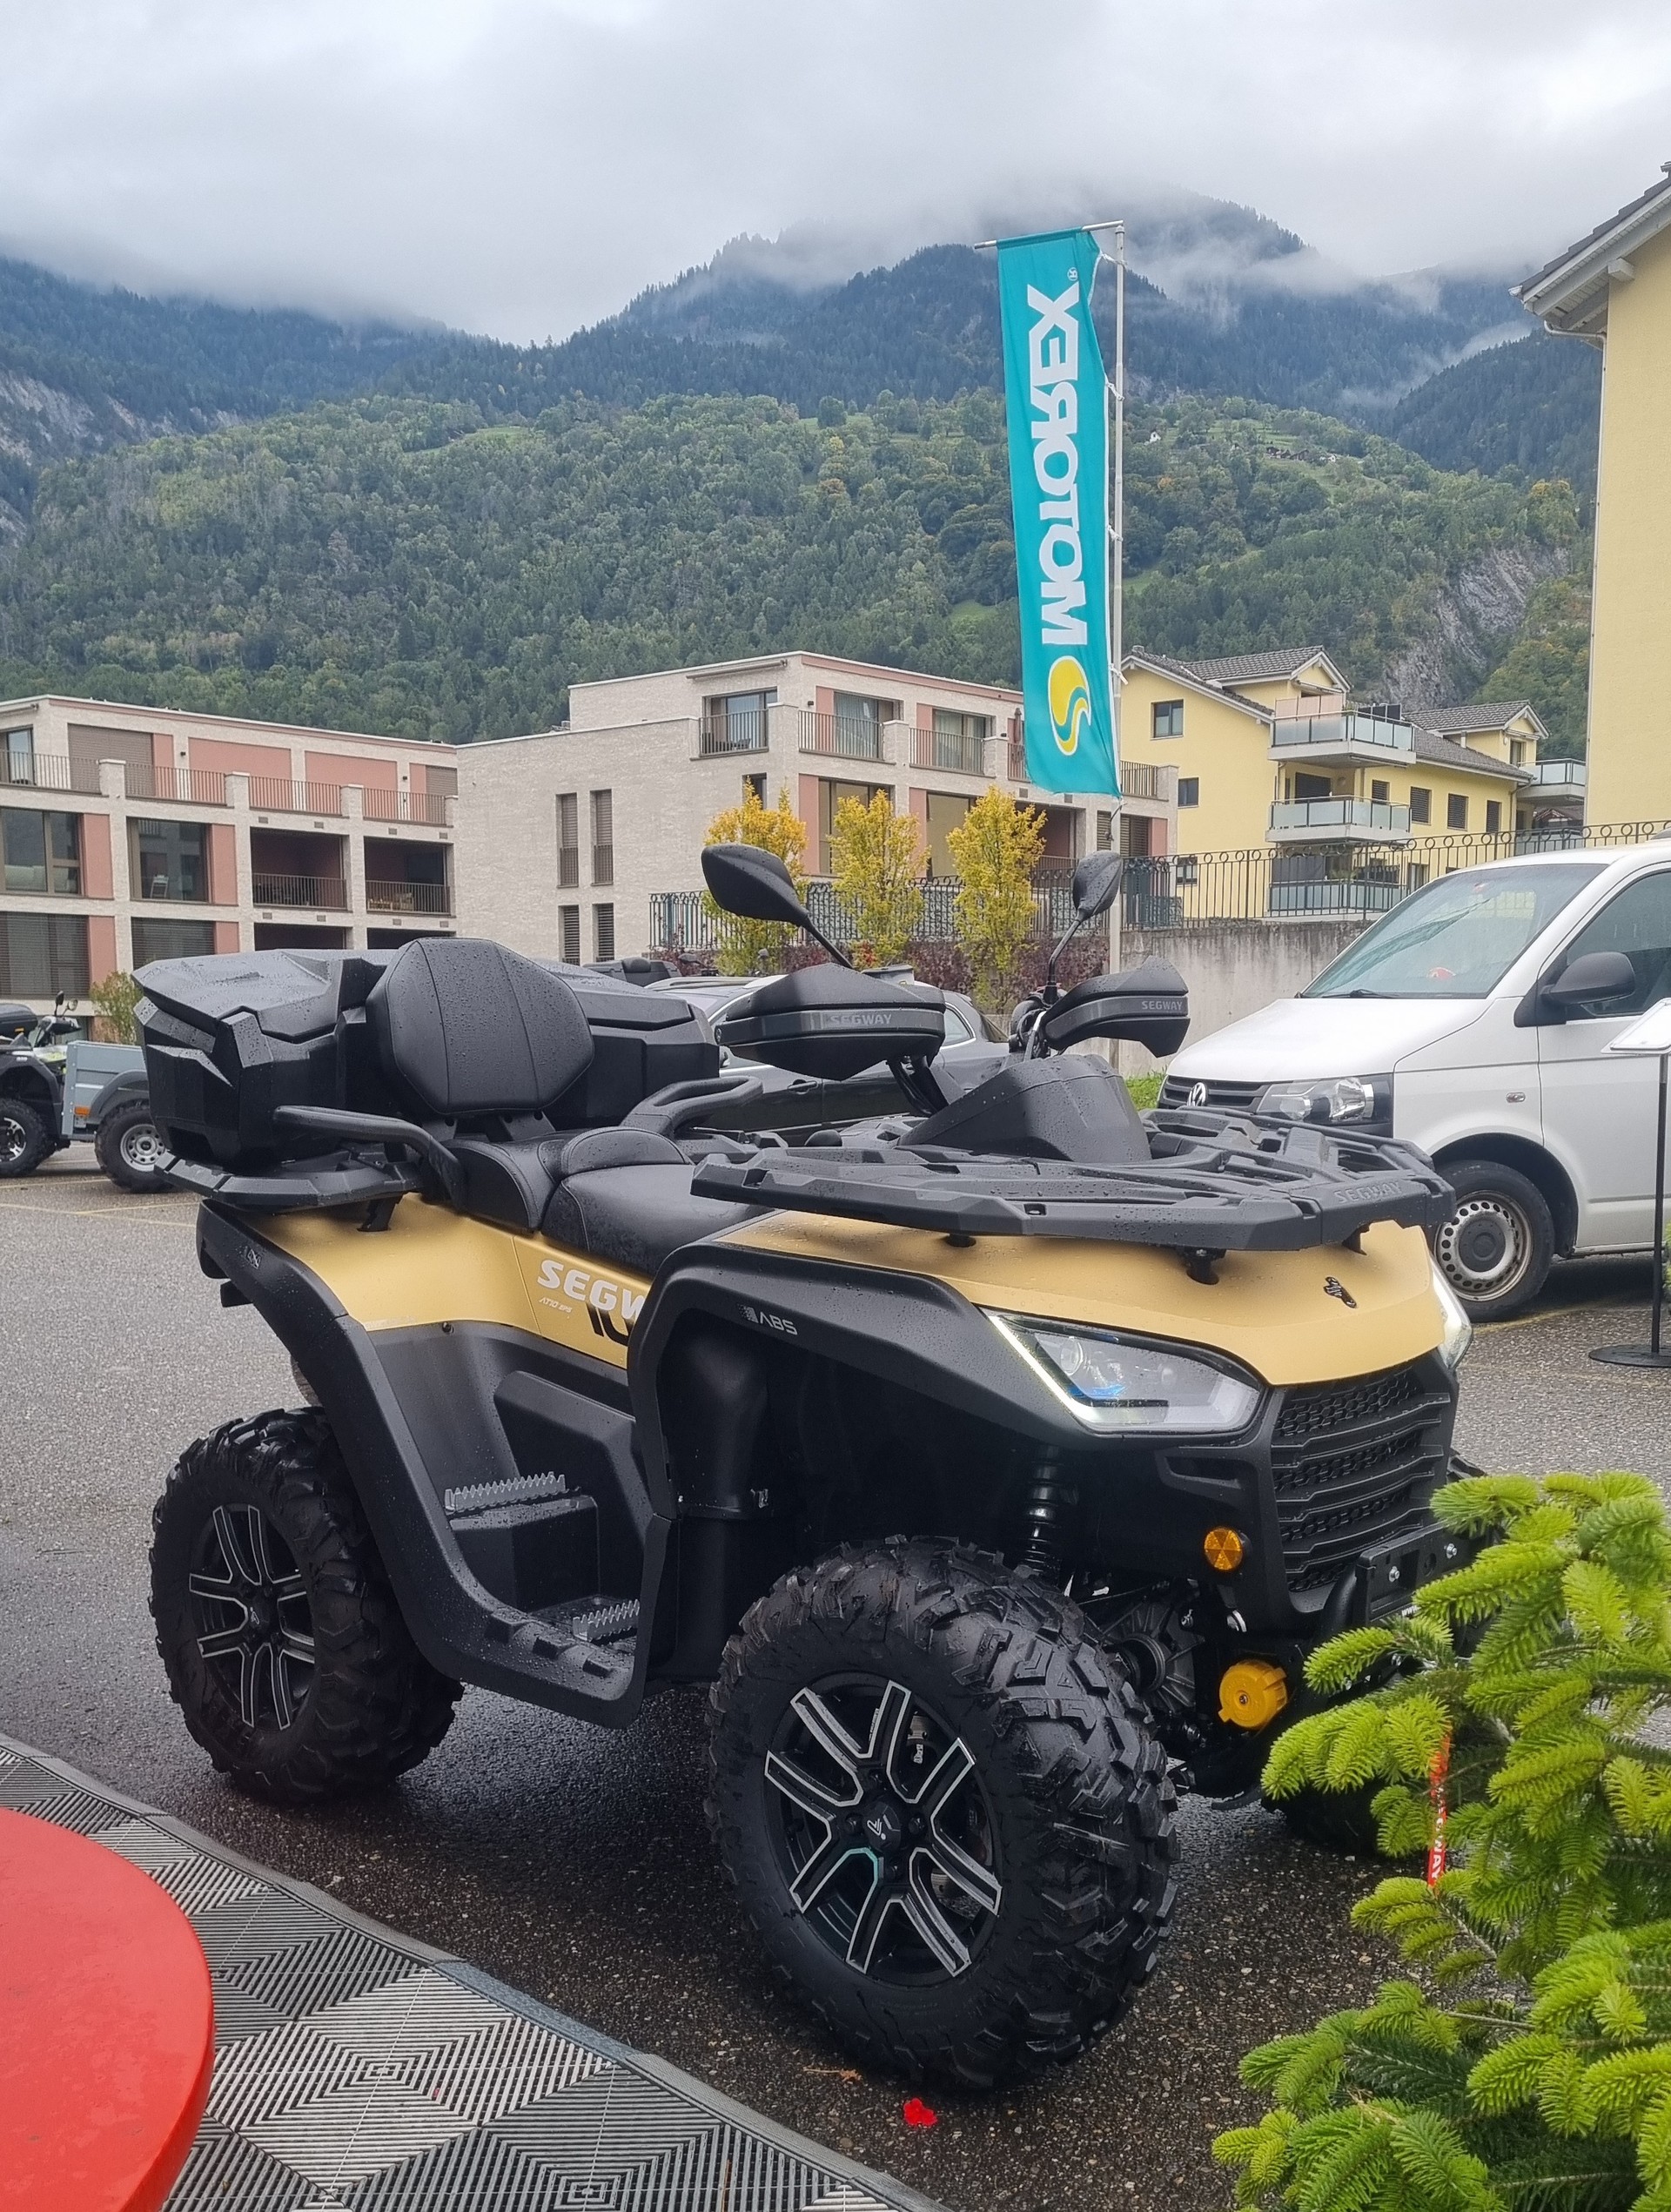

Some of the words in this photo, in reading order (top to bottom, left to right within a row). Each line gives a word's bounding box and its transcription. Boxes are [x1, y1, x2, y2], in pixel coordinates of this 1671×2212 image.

[1142, 1000, 1183, 1011] SEGWAY
[829, 1014, 892, 1025] SEGWAY
[1333, 1182, 1403, 1202] SEGWAY
[760, 1311, 798, 1335] ABS
